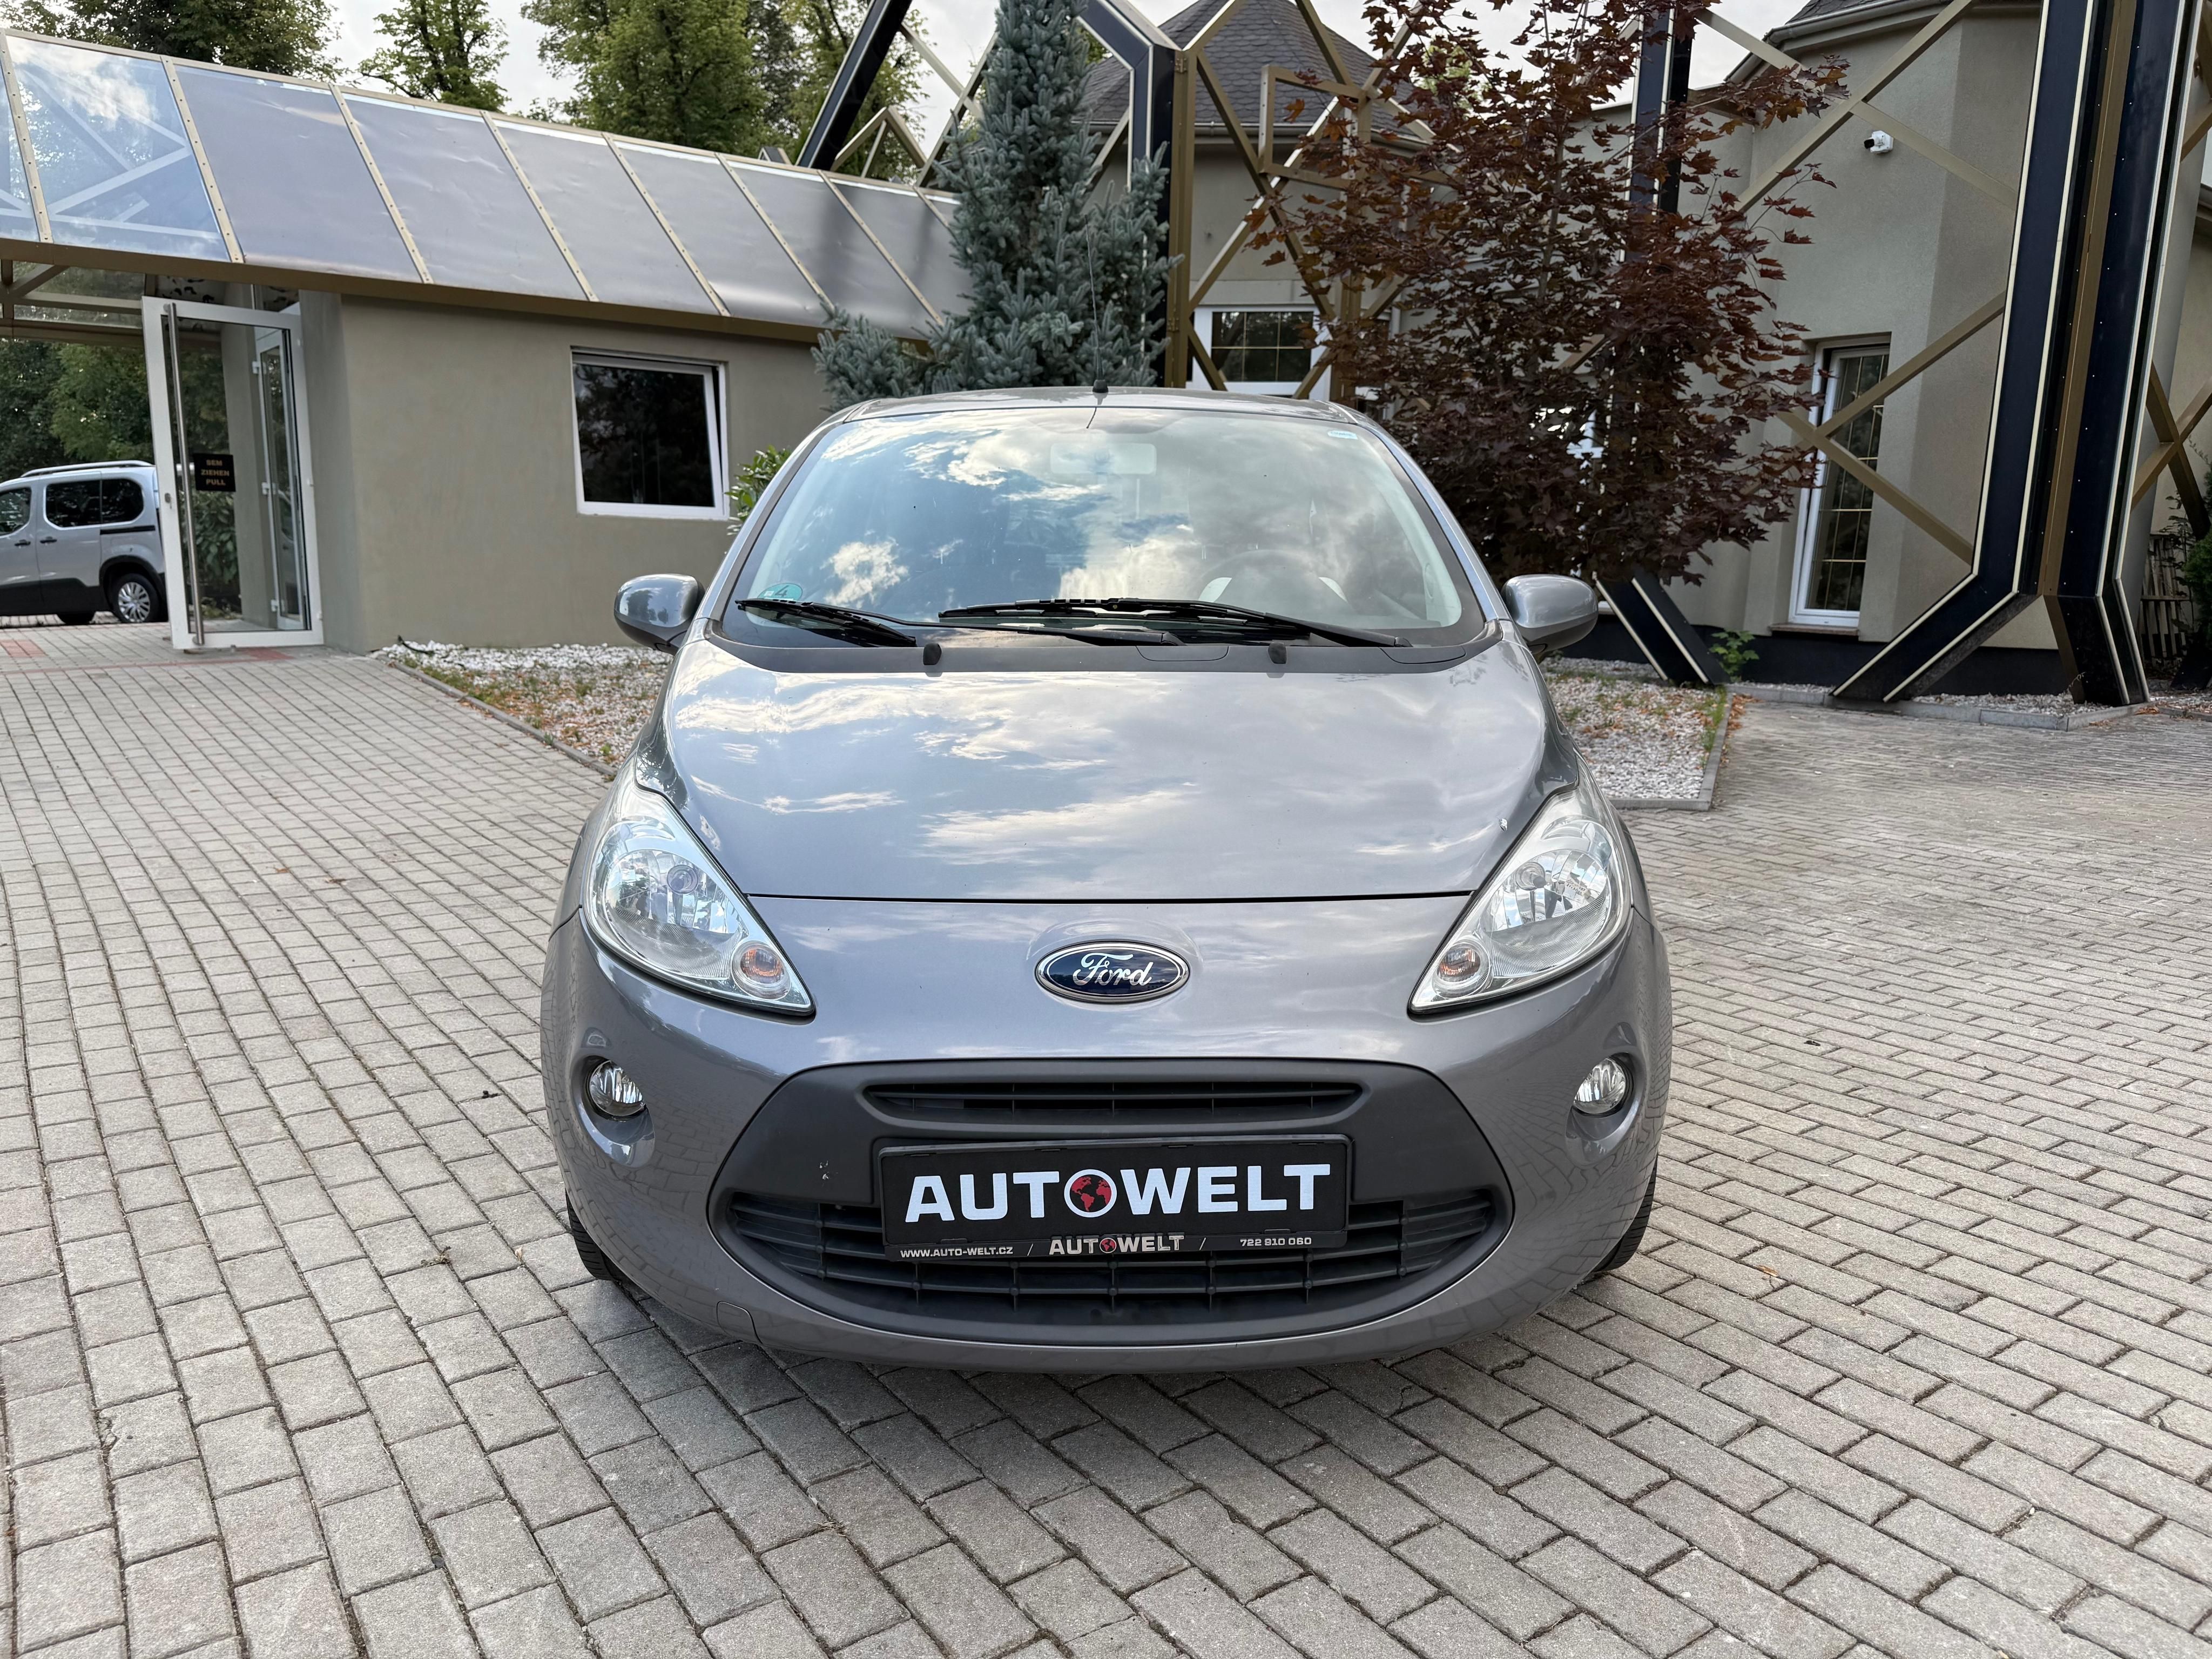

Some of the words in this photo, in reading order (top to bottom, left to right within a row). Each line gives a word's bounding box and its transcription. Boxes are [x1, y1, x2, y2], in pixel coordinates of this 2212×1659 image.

[775, 585, 789, 597] 4
[1073, 953, 1154, 986] Ford
[905, 1164, 1331, 1223] AUTOWELT
[900, 1246, 1014, 1258] WWW.AUTO-WELT.CZ
[1049, 1235, 1185, 1256] AUTOWELT
[1240, 1239, 1262, 1247] 722
[1264, 1238, 1286, 1246] 910
[1288, 1237, 1312, 1245] 060
